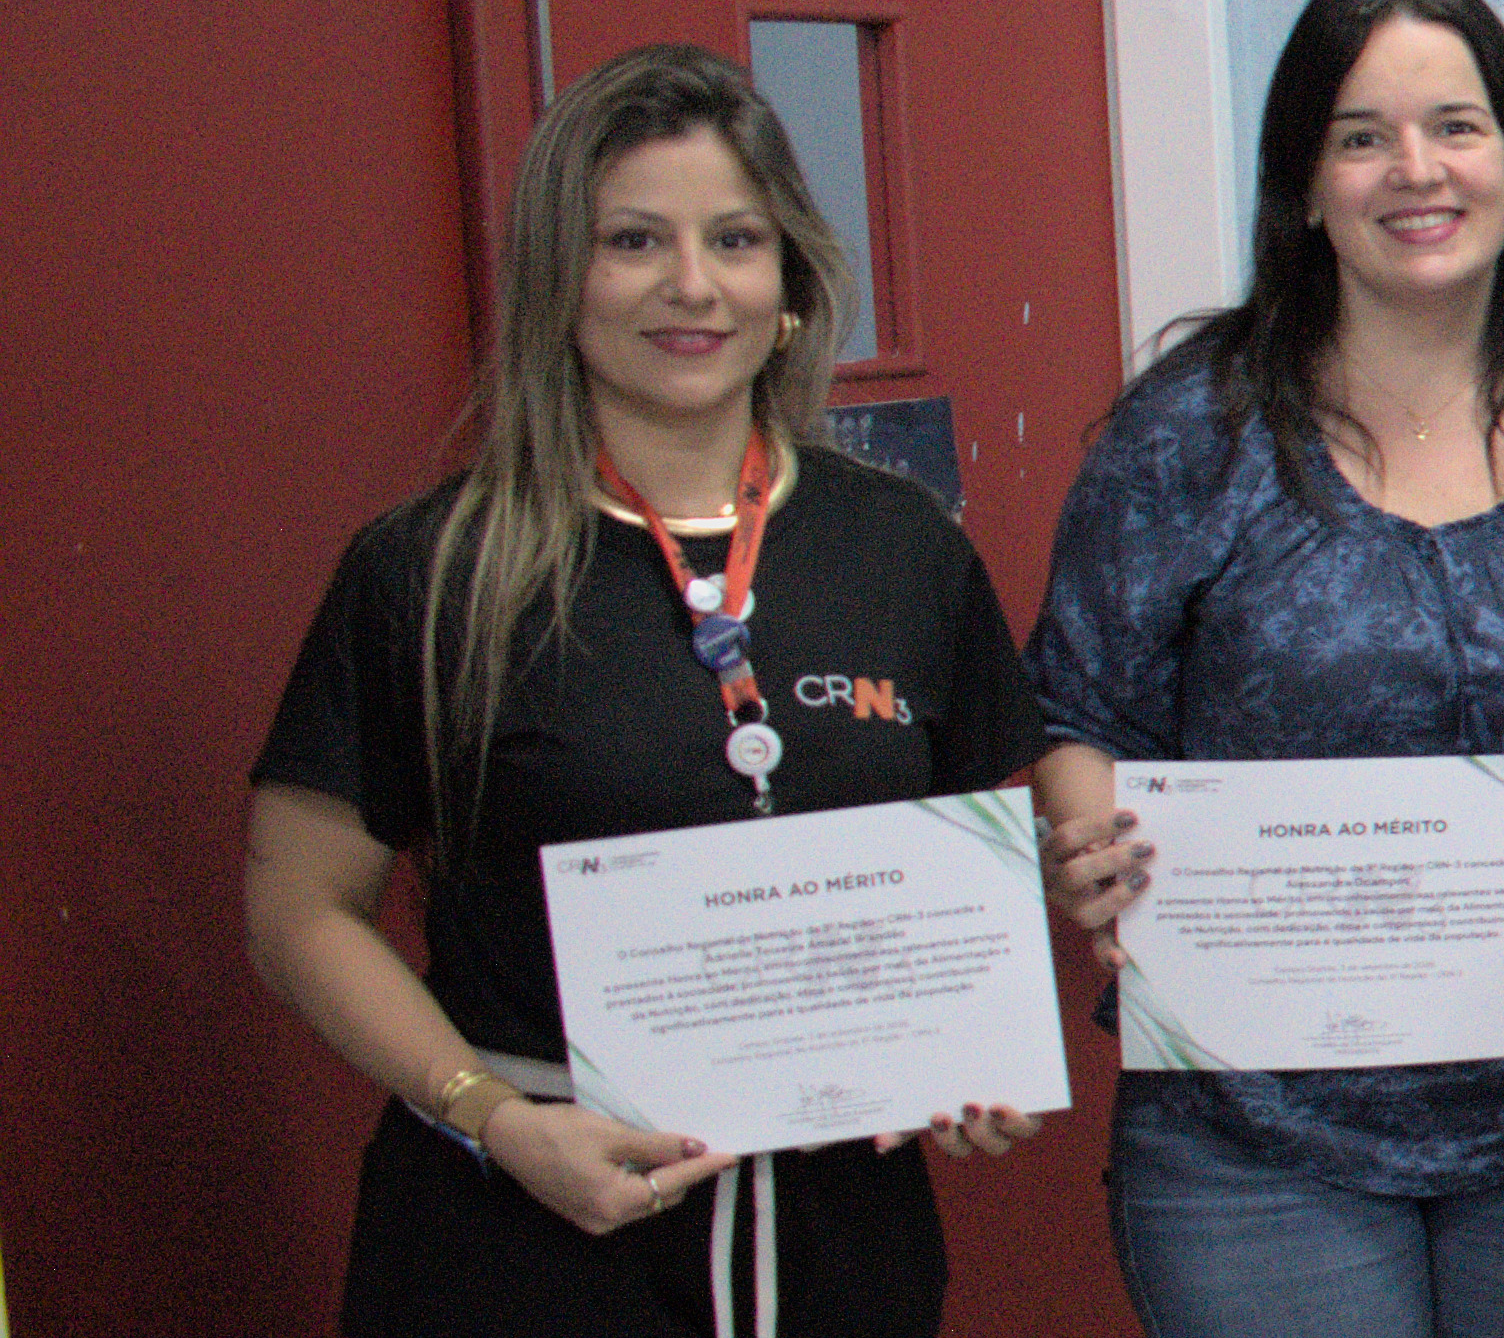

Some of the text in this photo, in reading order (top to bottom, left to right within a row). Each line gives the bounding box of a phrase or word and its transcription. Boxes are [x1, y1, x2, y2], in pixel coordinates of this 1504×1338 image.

[1259, 816, 1446, 838] HONRA AO MÉRITO
[704, 865, 904, 909] HONRA AO MÉRITO
